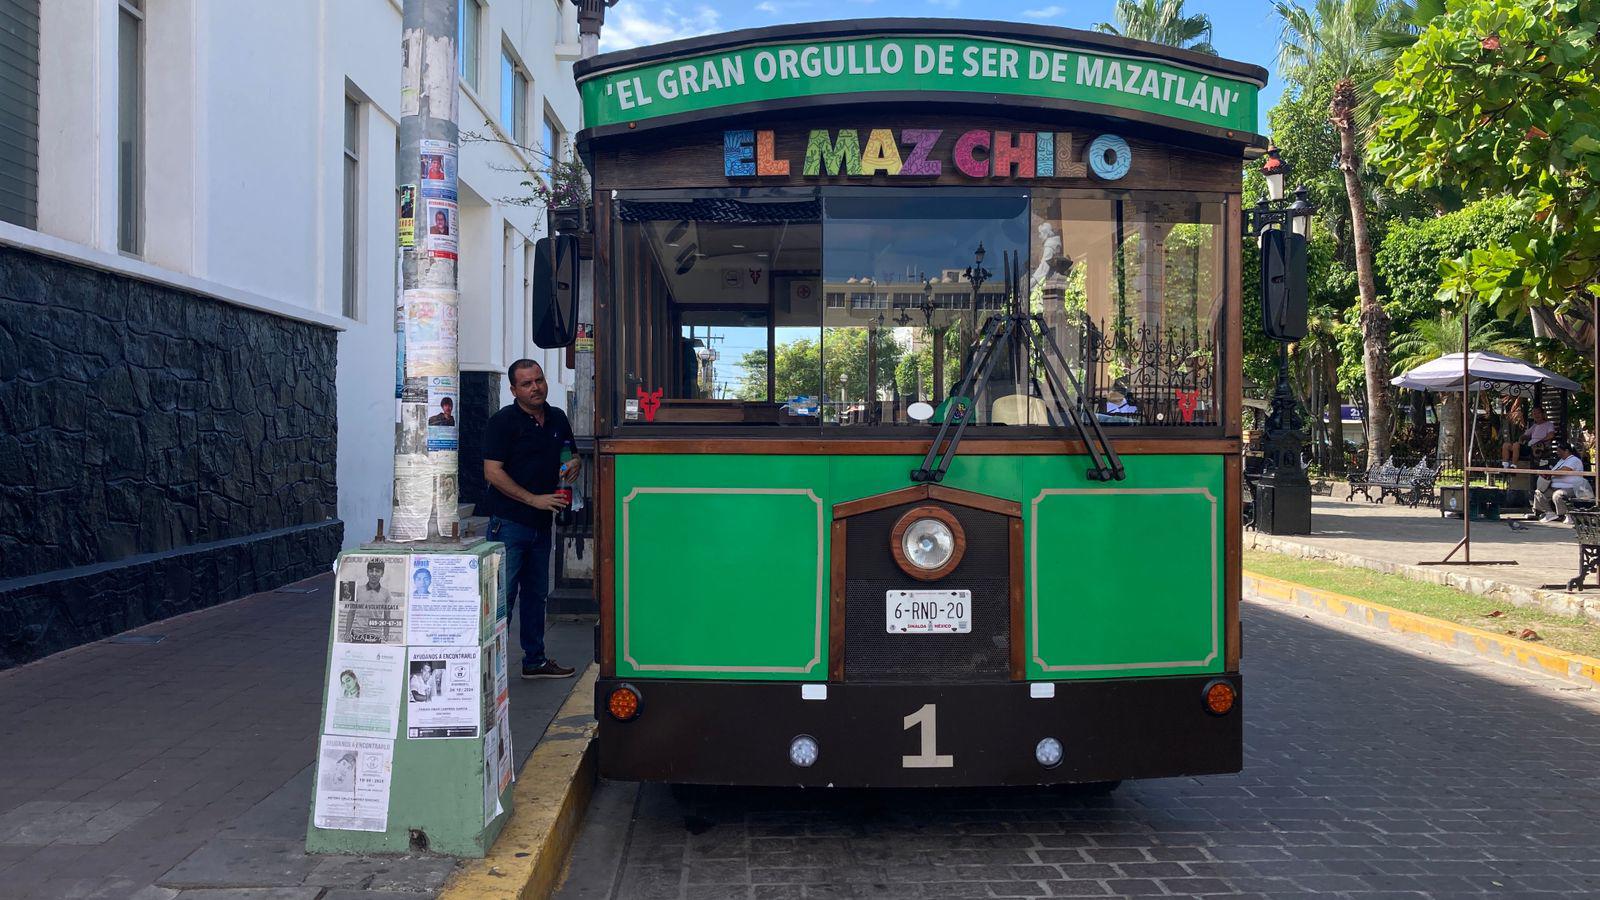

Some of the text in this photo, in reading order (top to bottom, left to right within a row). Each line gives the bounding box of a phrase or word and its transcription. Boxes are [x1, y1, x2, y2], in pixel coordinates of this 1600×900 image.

[657, 55, 745, 99] GRAN
[754, 43, 903, 82] ORGULLO
[914, 44, 954, 75] DE
[962, 46, 1019, 79] SER
[1028, 50, 1068, 83] DE
[724, 129, 1132, 181] EL MAZ CHILO
[894, 601, 964, 620] 6-RND-20
[902, 703, 954, 768] 1
